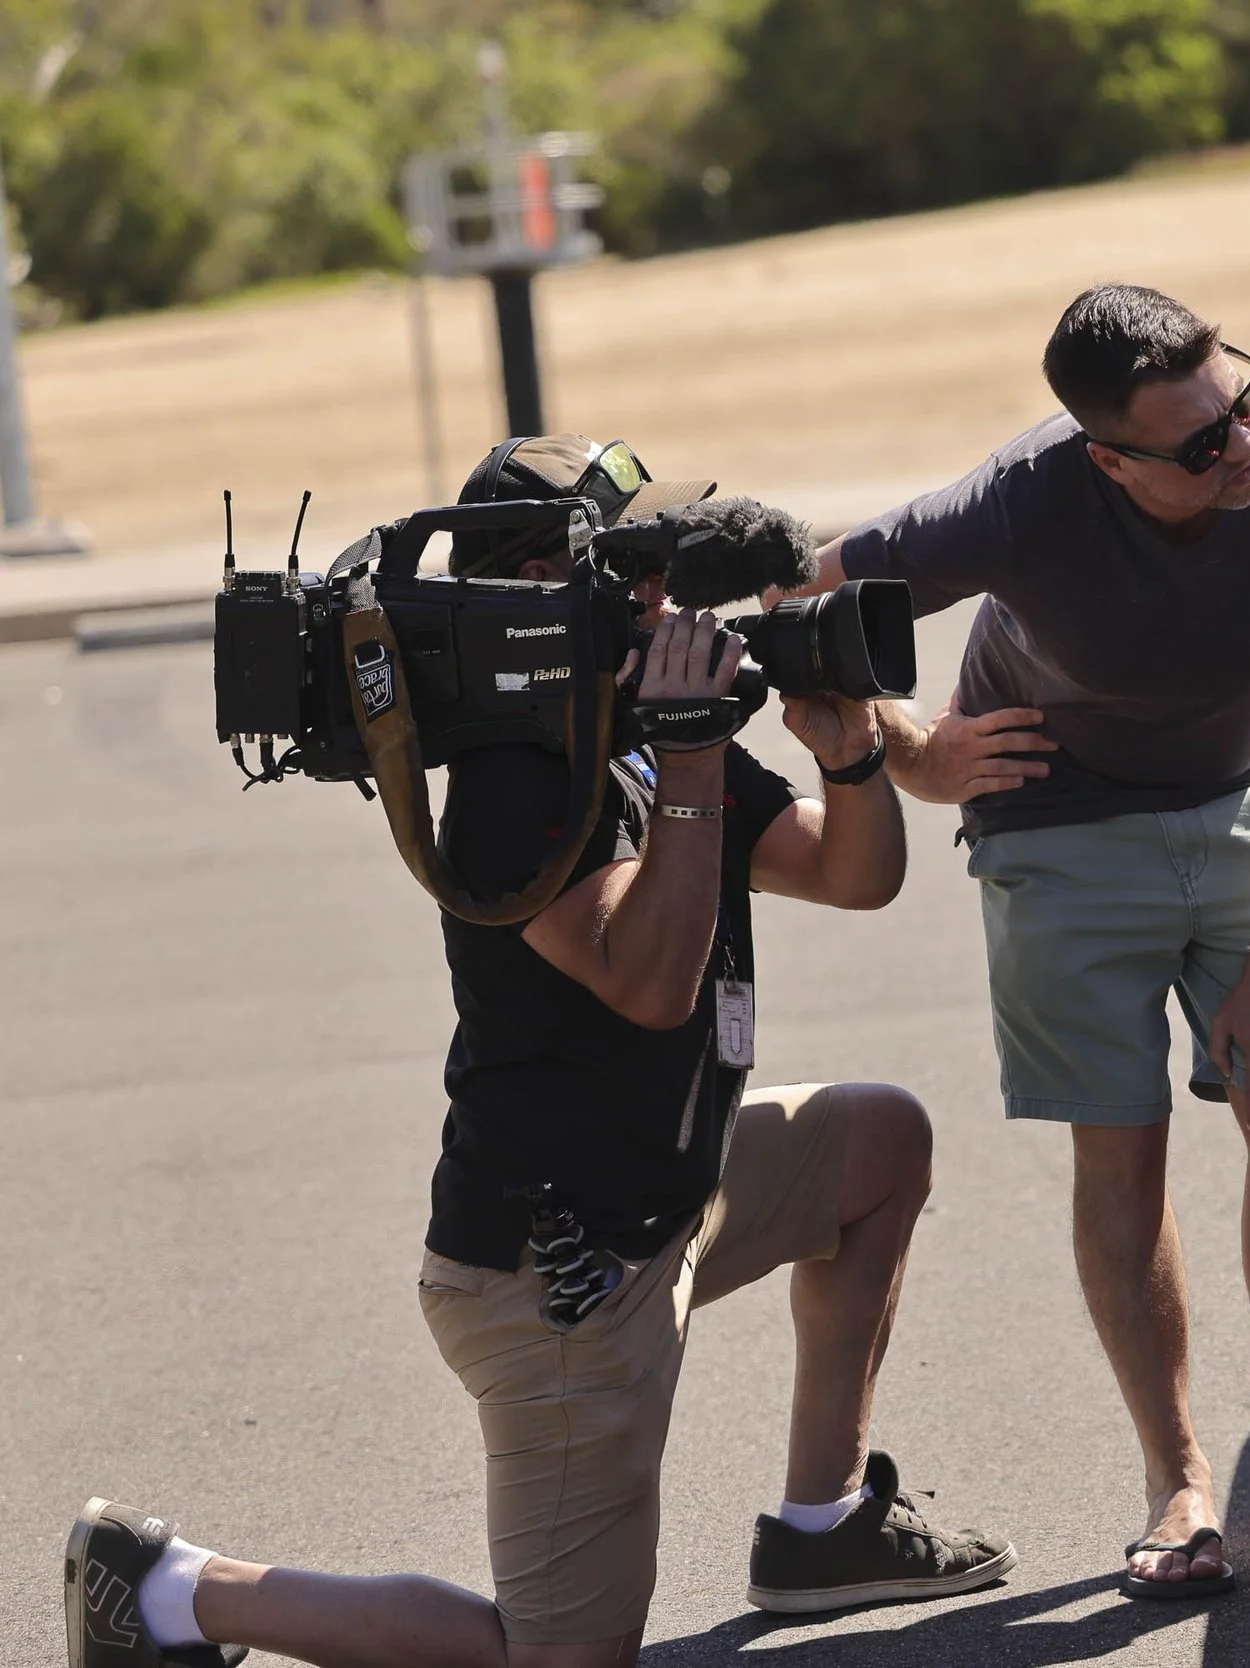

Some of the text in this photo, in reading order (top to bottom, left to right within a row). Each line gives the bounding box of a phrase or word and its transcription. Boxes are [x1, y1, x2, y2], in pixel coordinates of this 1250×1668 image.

[506, 623, 567, 639] Panasonic
[533, 666, 571, 681] P2HD
[658, 708, 711, 721] FUJINON
